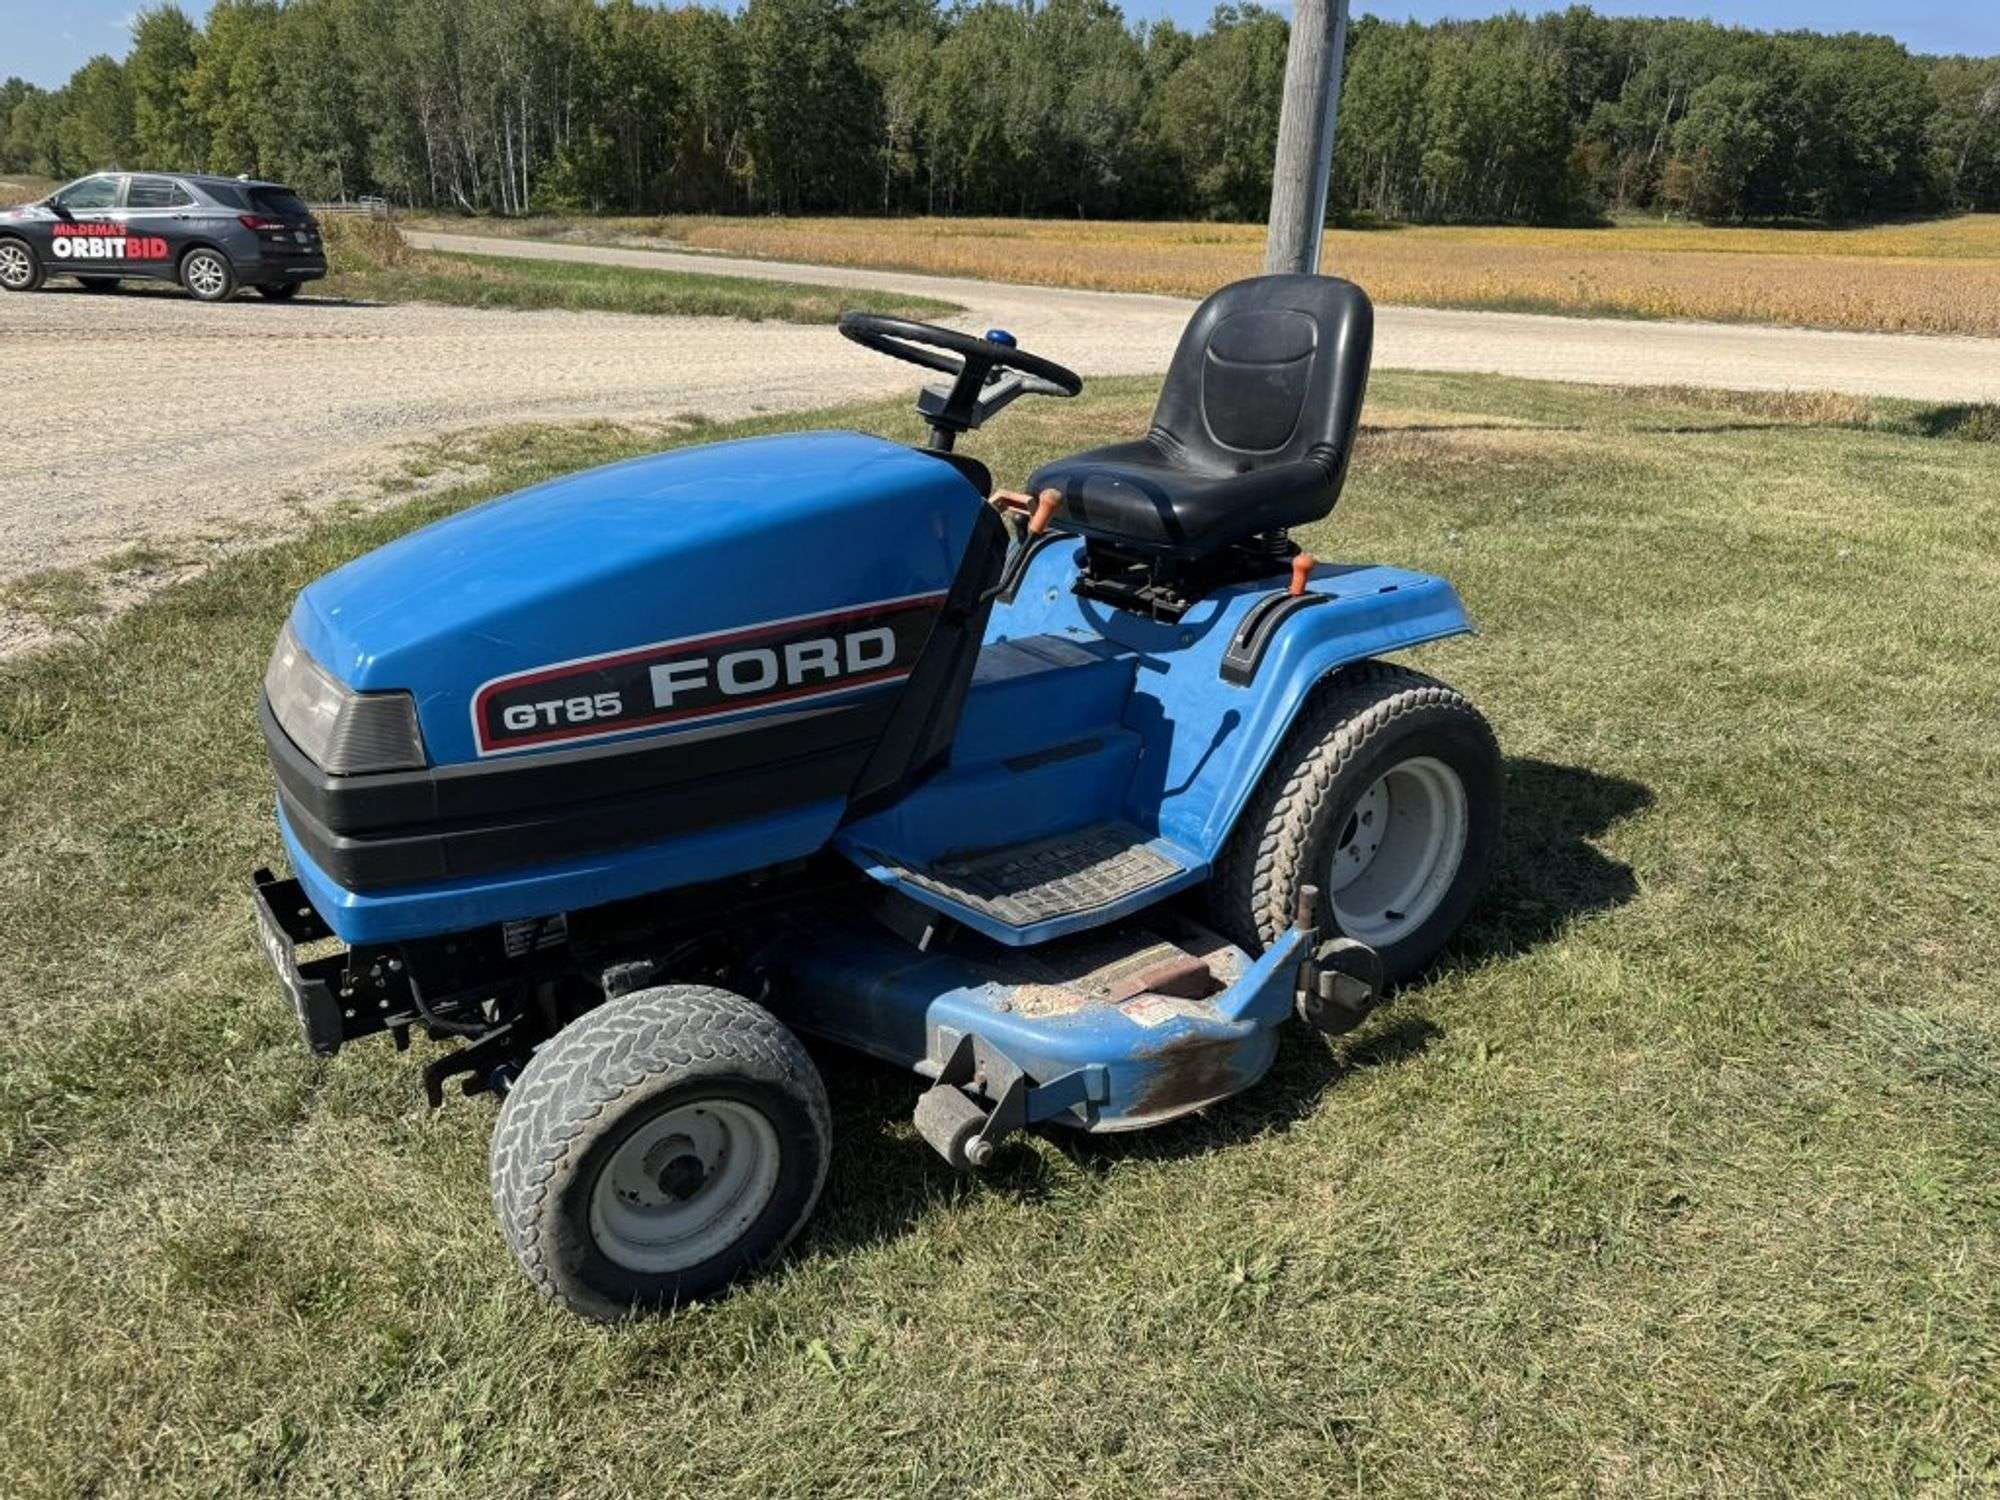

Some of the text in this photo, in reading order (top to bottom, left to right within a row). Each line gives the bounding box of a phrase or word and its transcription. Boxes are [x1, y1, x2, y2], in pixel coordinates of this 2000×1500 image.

[52, 237, 168, 258] ORBITBID
[503, 626, 896, 731] GT85 FORD
